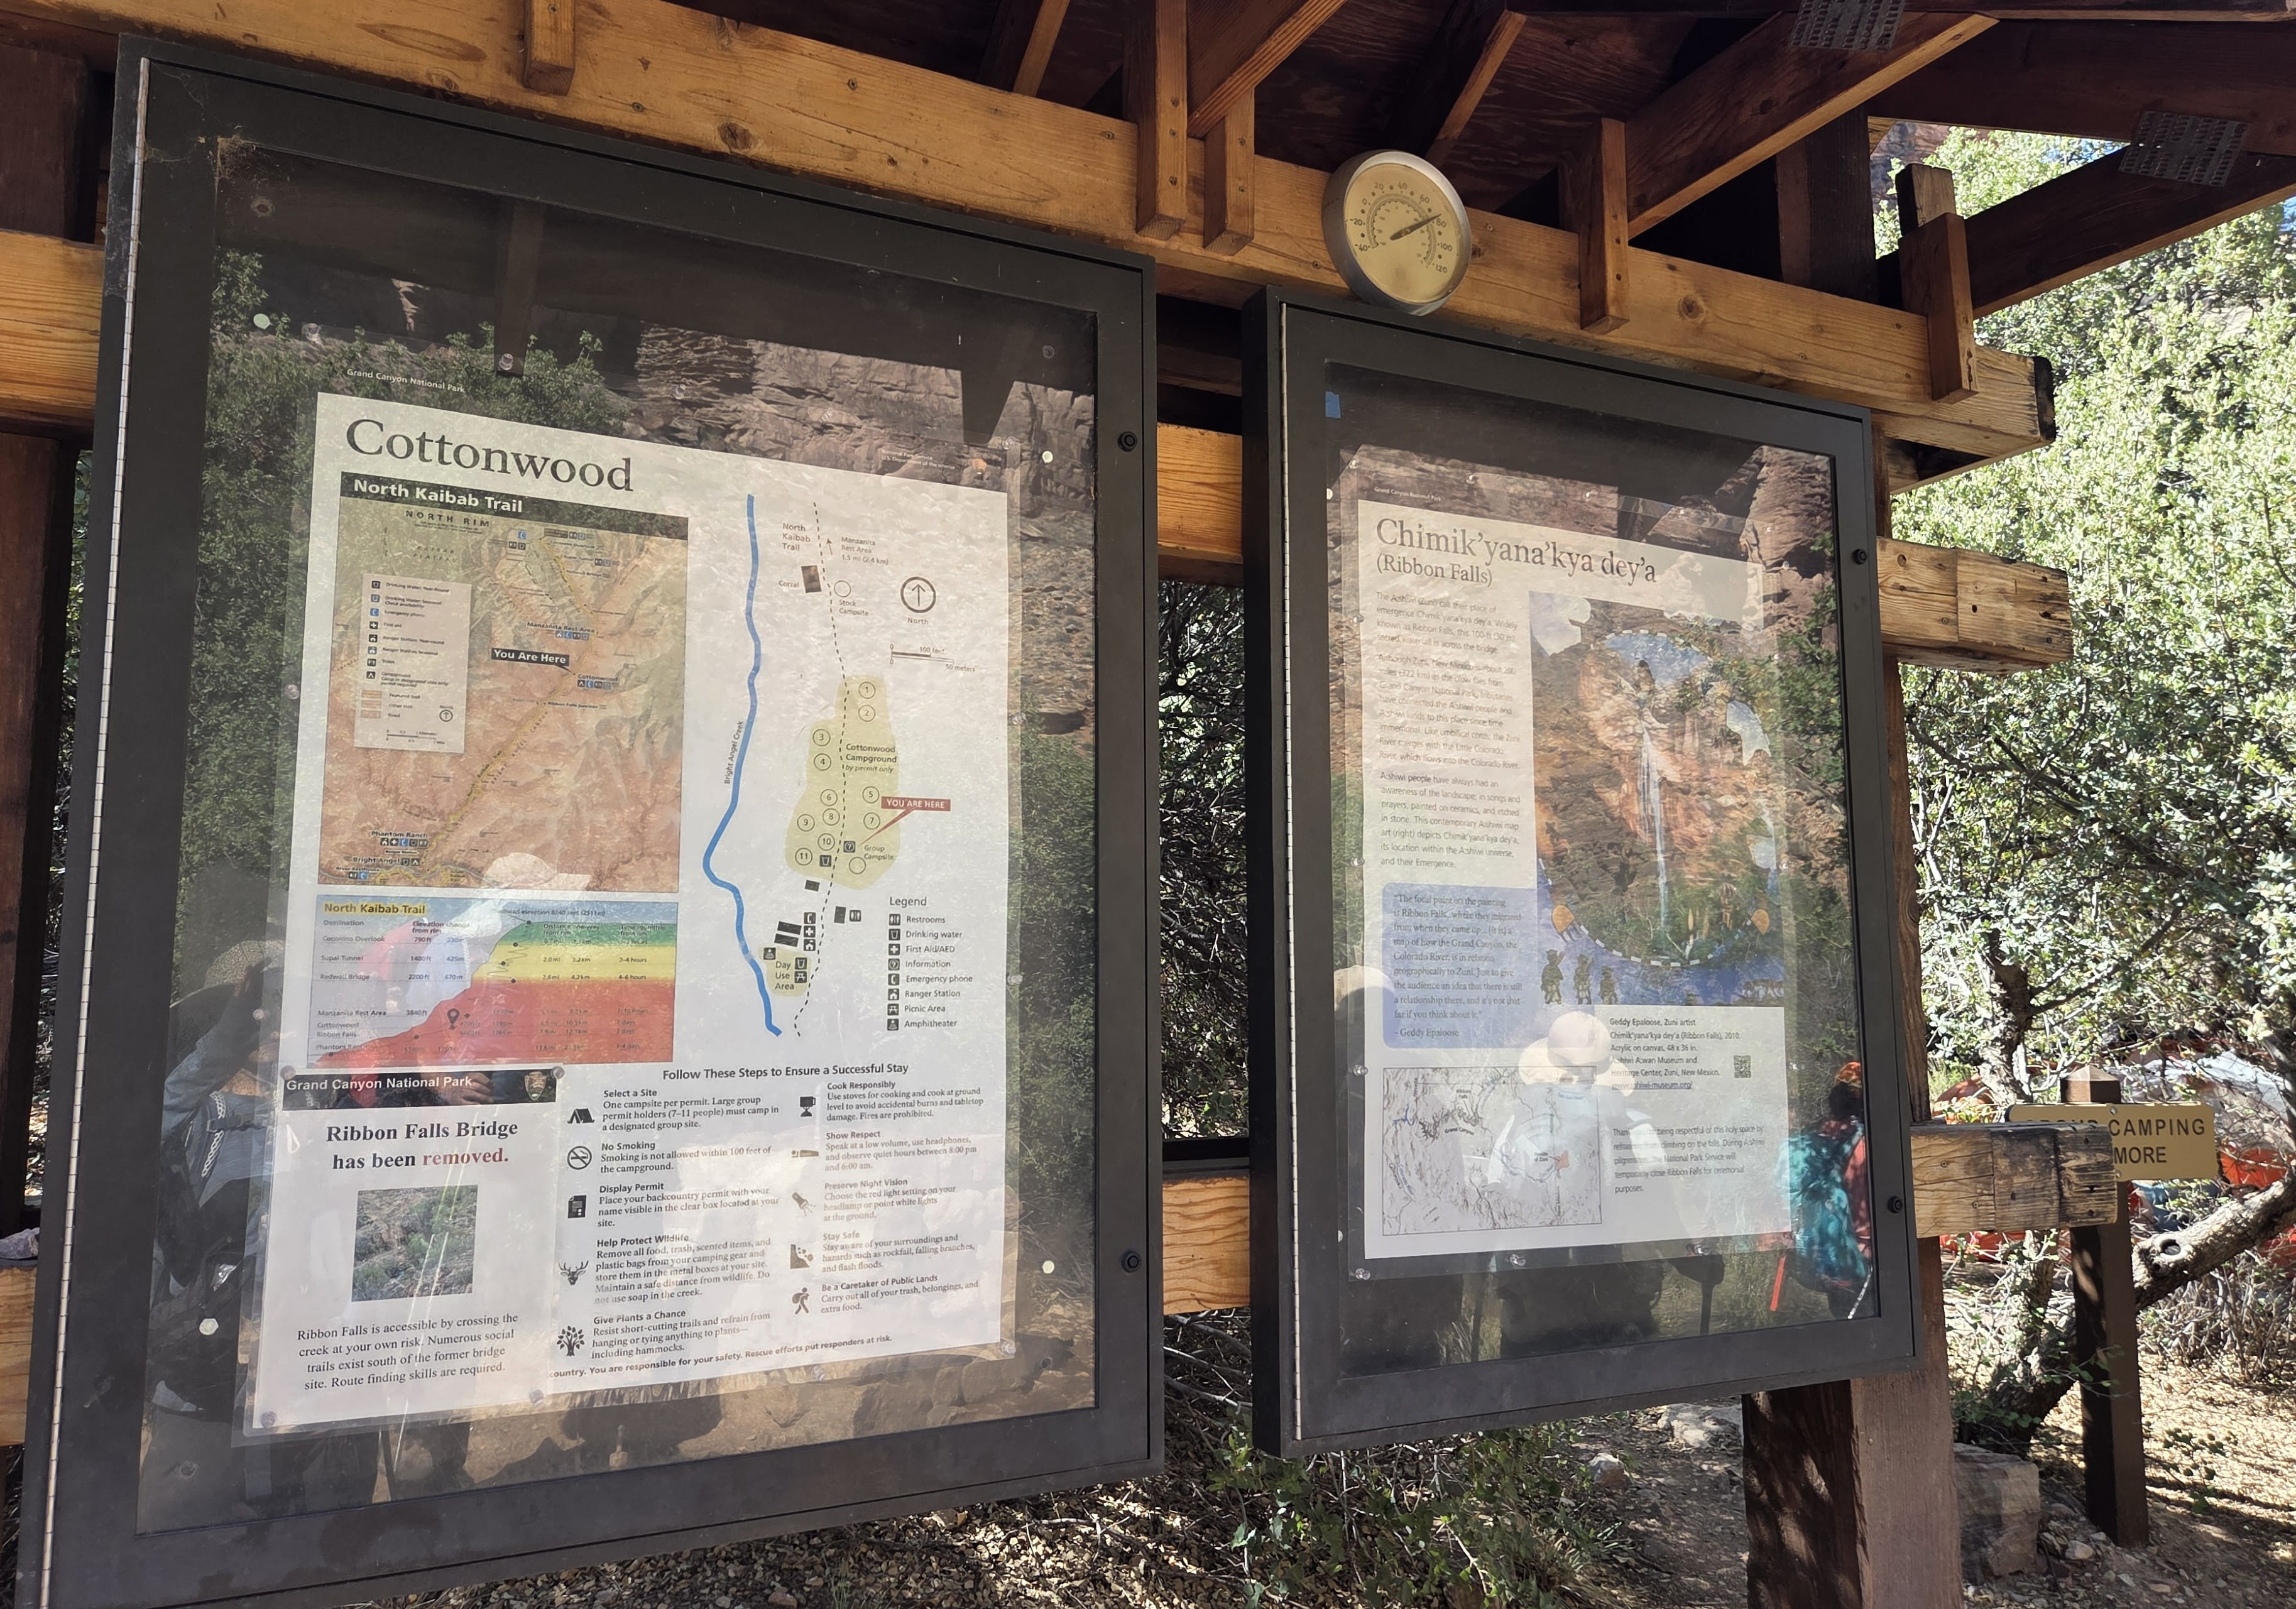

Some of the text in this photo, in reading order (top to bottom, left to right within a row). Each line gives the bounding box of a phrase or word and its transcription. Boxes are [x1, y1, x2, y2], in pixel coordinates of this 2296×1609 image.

[1419, 194, 1430, 204] 60
[1436, 218, 1446, 227] 80
[1436, 265, 1447, 273] 120
[346, 368, 466, 393] Grand Canyon National Park
[346, 418, 633, 491] Cottonwood
[354, 477, 522, 513] North Kaibab Trail
[405, 510, 454, 523] NORTH
[463, 517, 489, 528] RIM
[782, 522, 806, 532] North
[782, 532, 811, 543] Kaibab
[781, 542, 800, 551] Trail
[1377, 552, 1494, 588] (Ribbon Falls)
[778, 579, 799, 588] Corral
[838, 607, 868, 616] Campsite
[493, 649, 566, 663] You Are Here
[724, 721, 743, 784] Bright Angel Creek
[846, 743, 895, 752] Cottonwood
[845, 753, 897, 764] Campground
[845, 764, 854, 772] by
[878, 766, 894, 774] only
[886, 799, 944, 809] YOU ARE HERE
[863, 844, 885, 853] Group
[863, 853, 894, 861] Campsite
[889, 895, 927, 908] Legend
[324, 903, 425, 914] North Kaibab Trail
[906, 915, 946, 924] Restrooms
[905, 930, 939, 940] Drinking
[775, 960, 791, 971] Day
[905, 959, 951, 968] Information
[775, 971, 790, 979] Use
[905, 974, 973, 984] Emergency phone
[774, 982, 794, 990] Area
[904, 990, 931, 999] Ranger
[904, 1019, 957, 1028] Amphitheater
[1609, 1017, 1696, 1027] Geddy Epaloose, Zuni artist
[1399, 1027, 1424, 1039] Geddy
[1426, 1027, 1459, 1039] Epaloose
[663, 1069, 701, 1080] Follow
[703, 1067, 736, 1079] These
[738, 1067, 768, 1079] Steps
[770, 1067, 782, 1077] to
[785, 1066, 820, 1076] Ensure
[832, 1062, 884, 1074] Successful
[886, 1063, 909, 1075] Stay
[286, 1076, 473, 1091] Grand Canyon National Park
[826, 1080, 895, 1090] Cook Responsibly
[603, 1089, 630, 1098] Select
[640, 1088, 657, 1096] Site
[325, 1120, 518, 1142] Ribbon Falls Bridge
[2108, 1118, 2205, 1137] CAMPING
[826, 1130, 880, 1140] Show Respect
[601, 1140, 655, 1151] No Smoking
[332, 1147, 508, 1169] has been removed.
[2114, 1147, 2167, 1164] MORE
[599, 1182, 664, 1195] Display Permit
[860, 1179, 882, 1189] Night
[883, 1177, 908, 1186] Vision
[596, 1234, 689, 1248] Help Protect Wildlife
[823, 1230, 860, 1241] Stay Safe
[821, 1284, 831, 1292] Be
[840, 1280, 879, 1290] Caretaker
[880, 1277, 889, 1286] of
[891, 1276, 914, 1285] Public
[916, 1274, 938, 1283] Lands
[593, 1316, 614, 1324] Give
[616, 1314, 643, 1323] Plants
[653, 1310, 686, 1319] Chance
[297, 1312, 518, 1340] Ribbon Falls is accessible by crossing the
[298, 1344, 329, 1357] creek
[332, 1344, 342, 1354] at
[346, 1343, 371, 1355] your
[374, 1341, 397, 1350] own
[427, 1334, 481, 1345] Numerous
[484, 1328, 514, 1341] social
[307, 1346, 505, 1373] trails exist south of the former bridge
[304, 1361, 505, 1390] site. Route finding skills are required.
